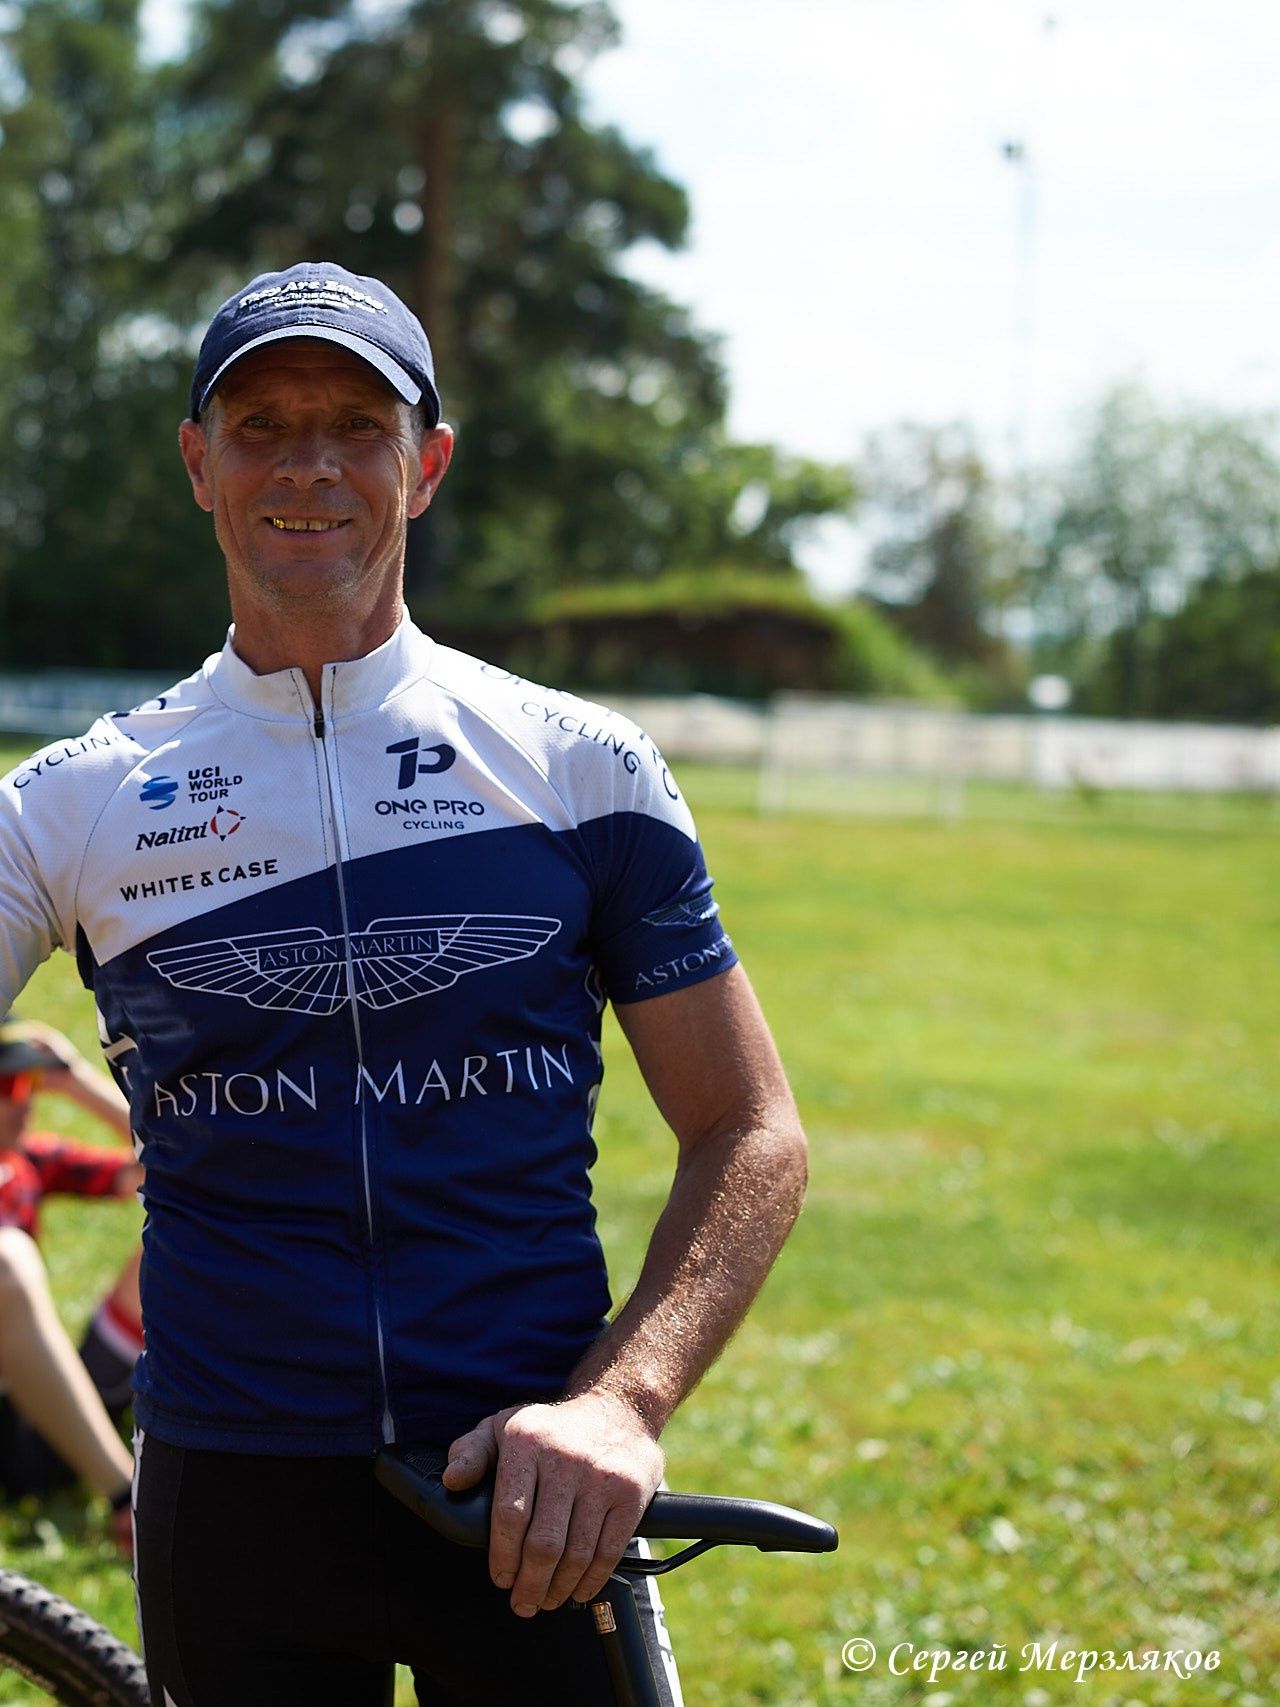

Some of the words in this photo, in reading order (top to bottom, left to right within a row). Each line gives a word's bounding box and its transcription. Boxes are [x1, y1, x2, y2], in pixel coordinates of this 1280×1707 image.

[520, 701, 641, 774] CYCLING
[187, 766, 221, 780] UCI
[188, 774, 243, 792] WORLD
[188, 788, 229, 804] TOUR
[433, 799, 485, 816] PRO
[135, 821, 209, 851] Nalini
[402, 820, 465, 830] CYCLING
[120, 874, 195, 902] WHITE
[200, 871, 214, 887] &
[218, 859, 278, 883] CASE
[263, 943, 338, 968] ASTON
[348, 934, 433, 956] MARTIN
[635, 943, 722, 990] ASTON
[153, 1066, 318, 1118] ASTON
[354, 1043, 575, 1105] MARTIN
